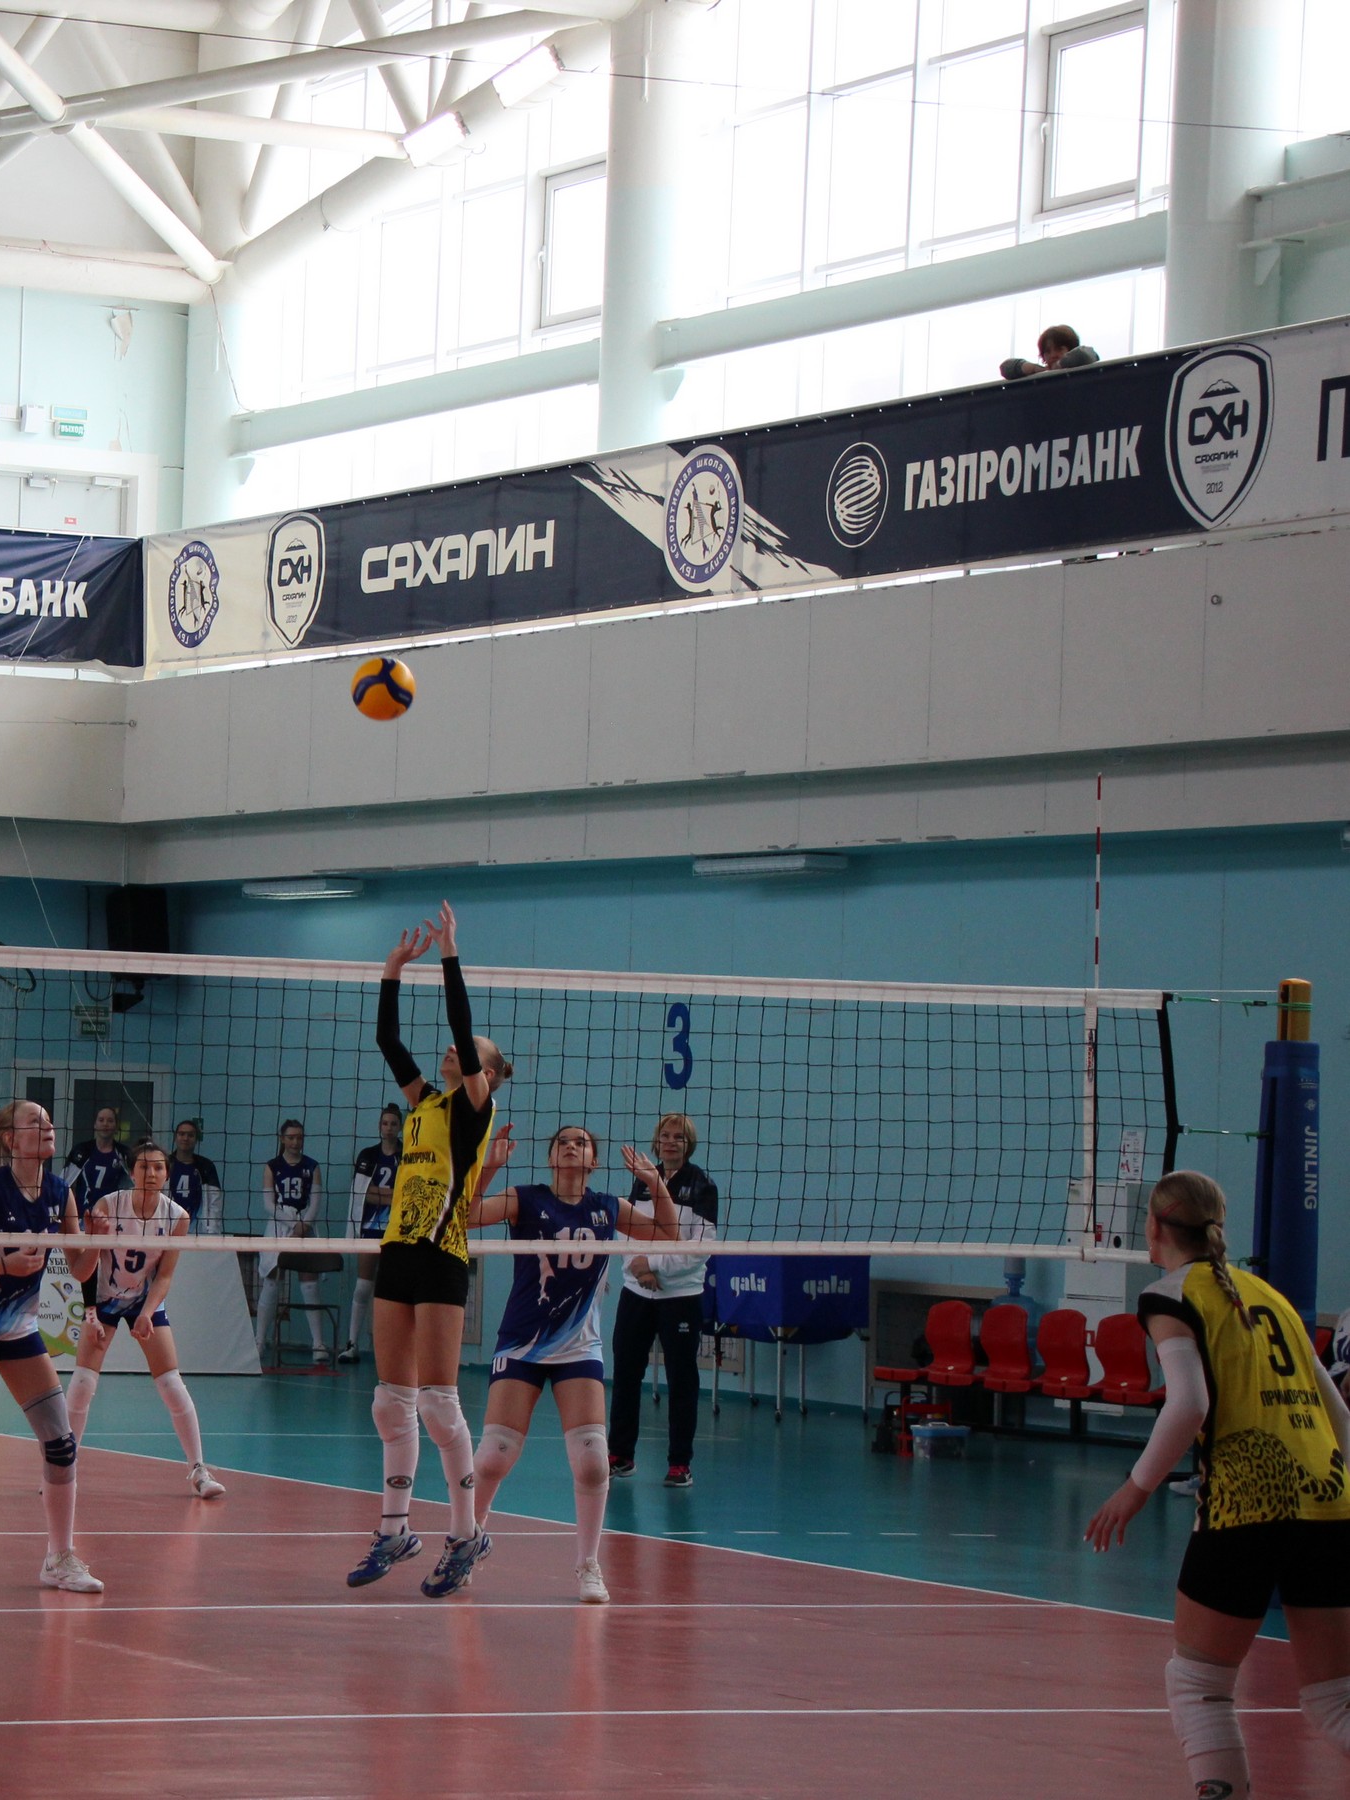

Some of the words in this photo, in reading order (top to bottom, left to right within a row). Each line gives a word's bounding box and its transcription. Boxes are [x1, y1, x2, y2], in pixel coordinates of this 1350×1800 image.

[903, 425, 1143, 511] ГАЗПРОМБАНК
[1206, 482, 1223, 494] 2012
[680, 563, 697, 579] ГБУ
[724, 473, 733, 489] по
[664, 1002, 693, 1090] 3
[95, 1165, 107, 1189] 7
[378, 1167, 392, 1189] 2
[1304, 1125, 1317, 1210] JINLING
[176, 1174, 190, 1198] 4
[281, 1177, 302, 1199] 13
[124, 1249, 146, 1273] 5
[730, 1273, 766, 1298] gala
[802, 1275, 850, 1301] gala
[1249, 1305, 1295, 1376] 3
[492, 1357, 507, 1375] 10
[1288, 1409, 1316, 1429] КРАЙ
